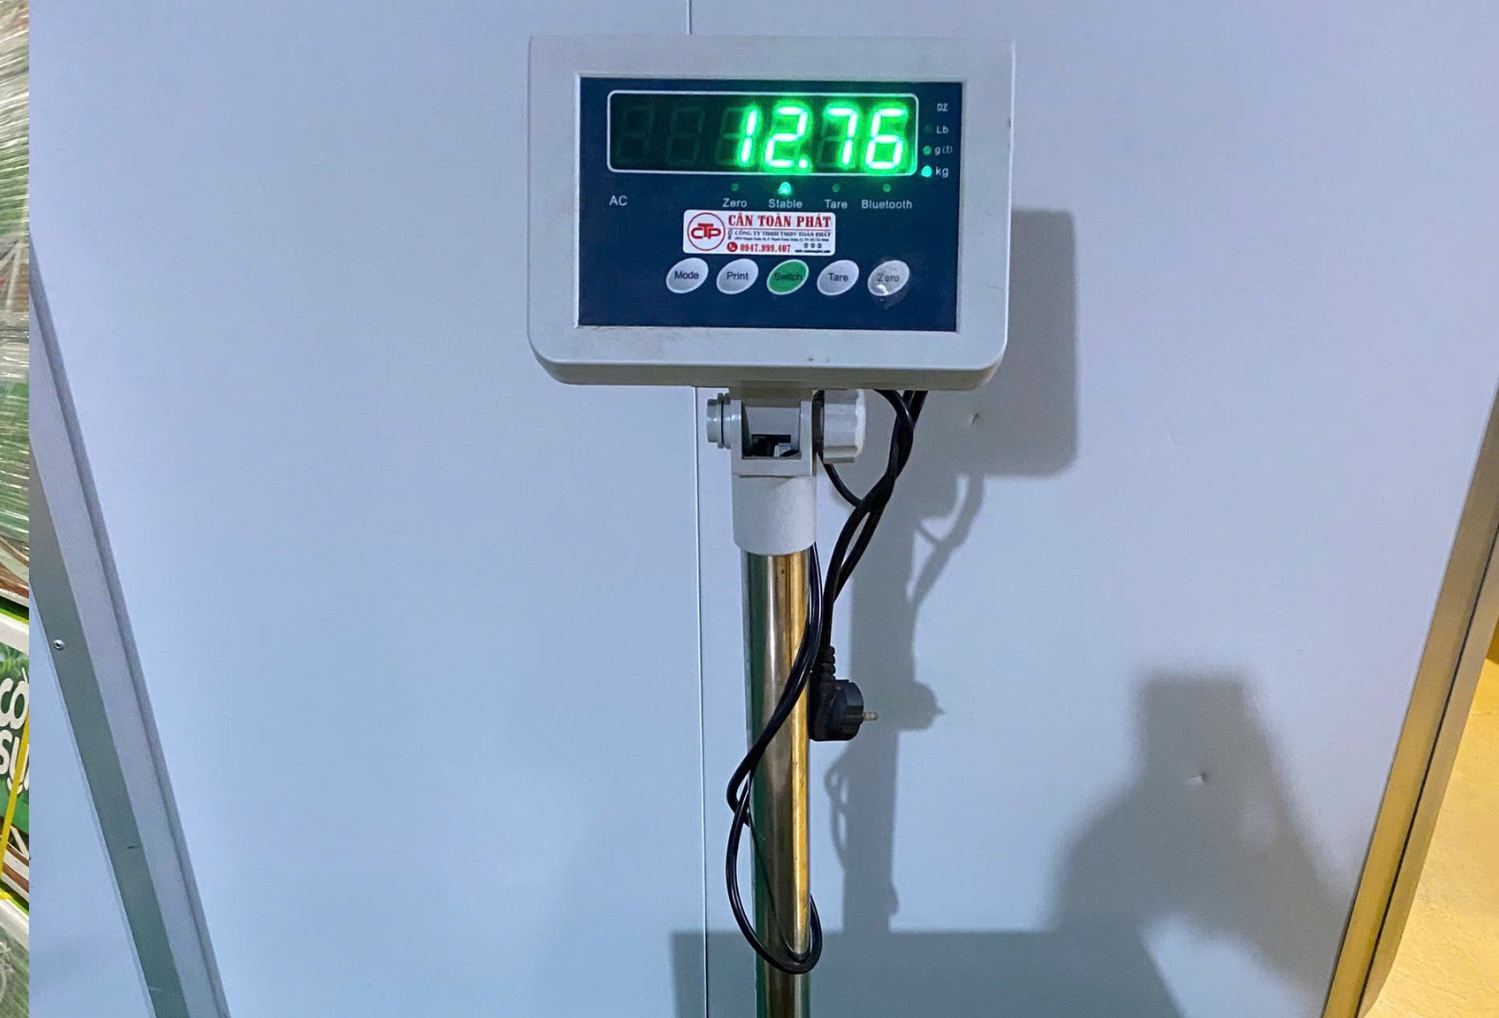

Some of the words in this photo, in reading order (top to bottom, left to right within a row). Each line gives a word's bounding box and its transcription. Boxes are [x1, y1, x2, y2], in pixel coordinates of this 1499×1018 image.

[936, 126, 949, 134] Lb
[737, 104, 910, 171] 12.76
[935, 166, 949, 178] kg
[609, 196, 628, 206] AC
[723, 198, 747, 208] Zero
[768, 199, 802, 208] Stable
[825, 200, 848, 209] Tare
[861, 199, 912, 209] Bluetooth
[757, 213, 791, 227] TOÀN
[797, 213, 831, 227] PHÁT
[674, 271, 699, 280] Mode
[727, 272, 749, 281] Print
[774, 272, 802, 281] Switch
[828, 273, 848, 282] Tare
[877, 274, 900, 283] Zero
